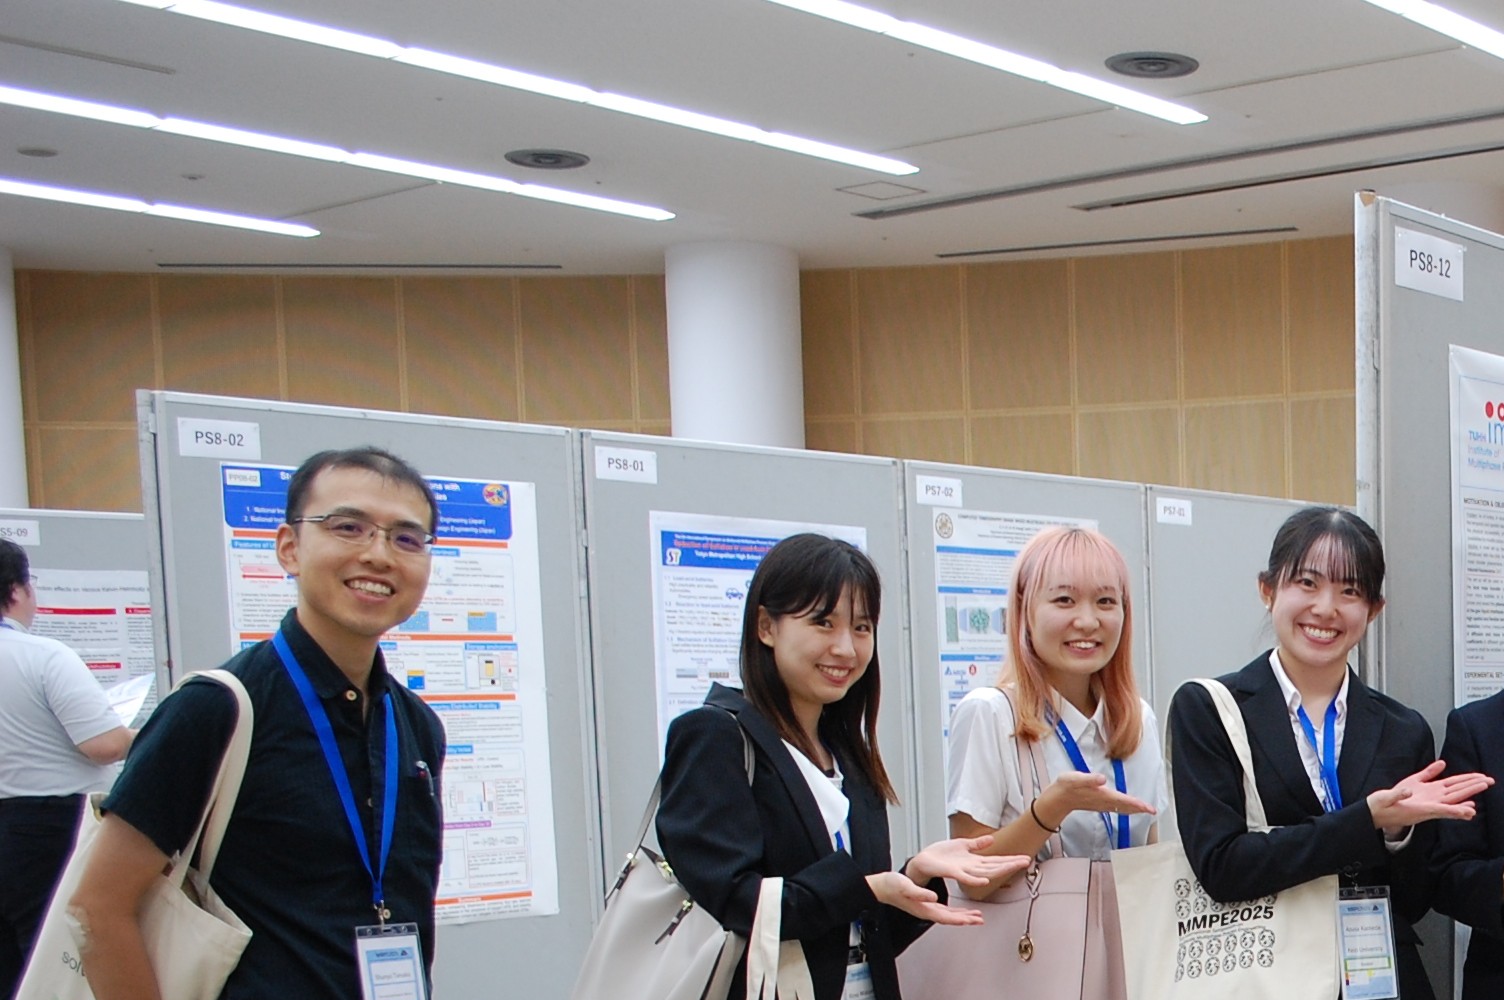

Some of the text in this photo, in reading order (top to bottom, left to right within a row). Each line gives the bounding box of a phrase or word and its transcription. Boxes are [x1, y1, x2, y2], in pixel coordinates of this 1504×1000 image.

[1409, 249, 1451, 279] PS8-12
[195, 430, 245, 447] PS8-02
[607, 457, 645, 472] PS8-01
[925, 484, 954, 498] PS7-02
[1178, 905, 1274, 936] MMPE2025
